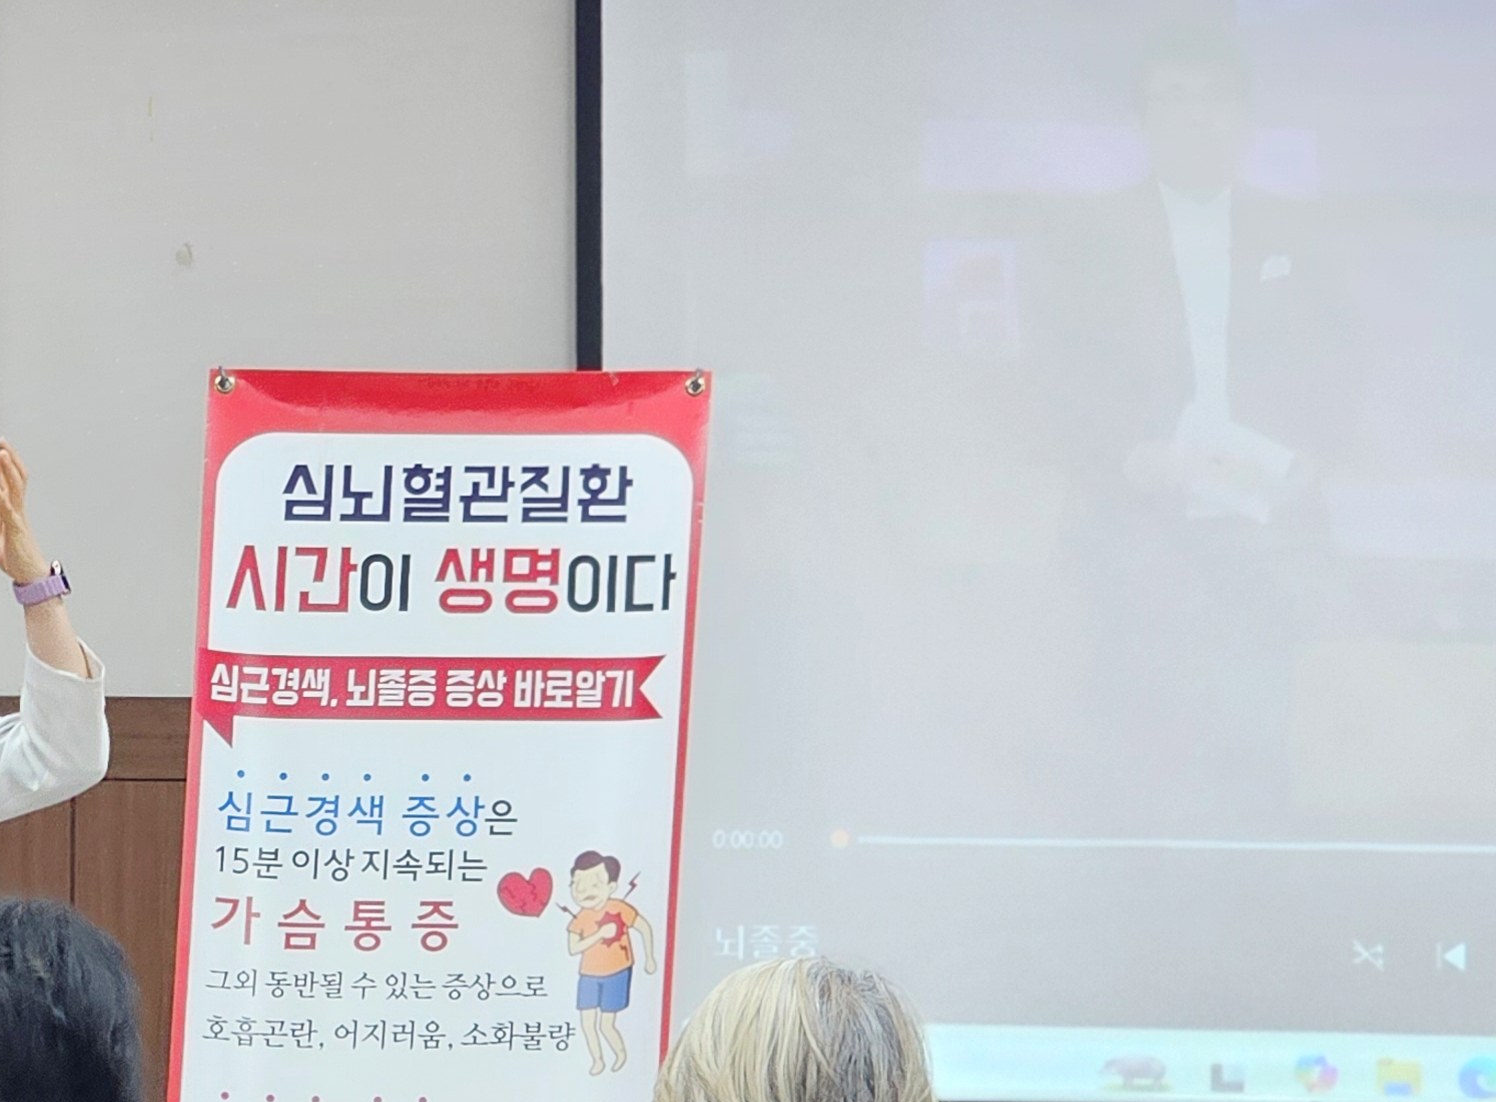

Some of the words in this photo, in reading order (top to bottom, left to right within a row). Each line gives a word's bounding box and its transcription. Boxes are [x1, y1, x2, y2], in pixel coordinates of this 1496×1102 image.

[282, 462, 634, 524] 심뇌혈관질환
[225, 544, 412, 613] 시간이
[434, 547, 677, 614] 생명이다
[210, 663, 338, 708] 심근경색,
[445, 669, 508, 709] 증상
[513, 669, 634, 709] 바로알기
[217, 790, 385, 837] 심근경색
[401, 794, 519, 838] 증상은
[215, 845, 284, 880] 15분
[291, 847, 356, 882] 이상
[360, 848, 488, 883] 지속되는
[715, 924, 819, 960] 뇌졸중
[205, 968, 258, 997] 그외
[264, 970, 343, 999] 동반될
[350, 971, 378, 1000] 수
[385, 971, 437, 1000] 있는
[441, 972, 548, 1001] 증상으로
[202, 1014, 325, 1050] 호흡곤란,
[334, 1019, 454, 1052] 어지러움,
[460, 1020, 576, 1052] 소화불량
